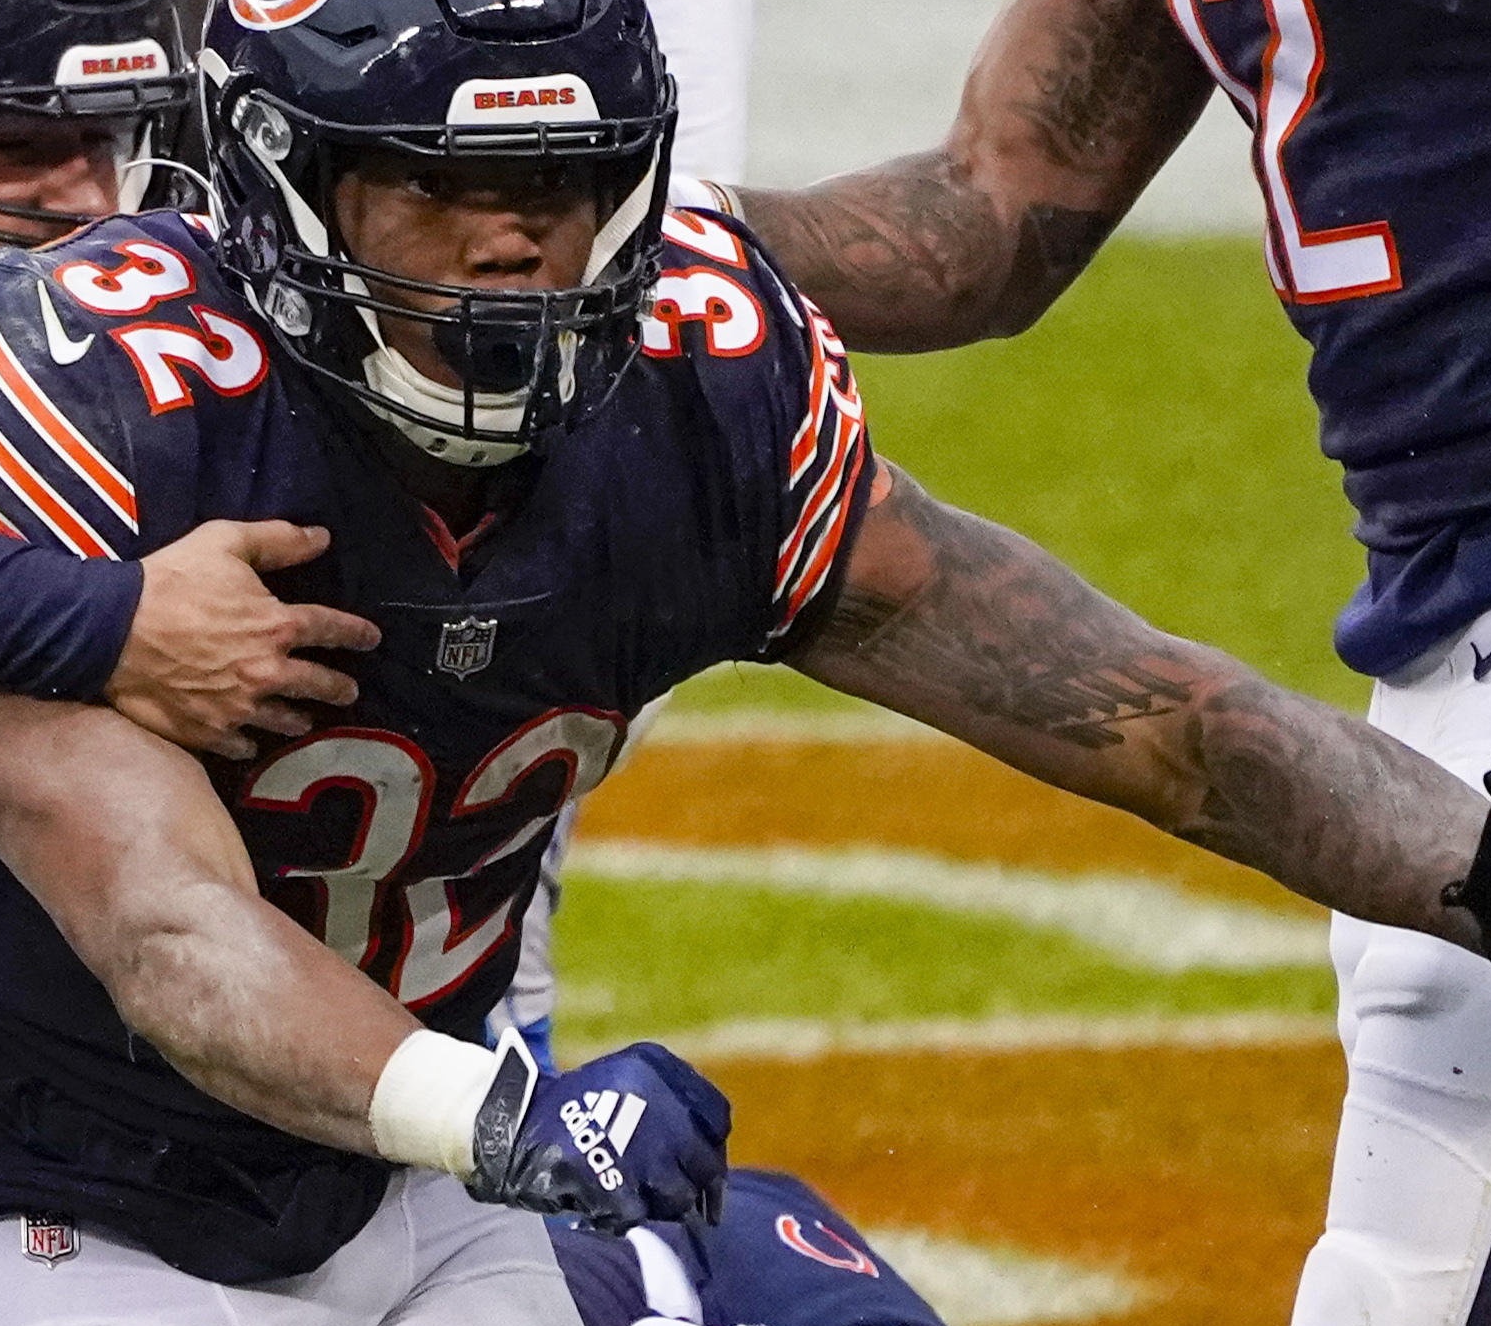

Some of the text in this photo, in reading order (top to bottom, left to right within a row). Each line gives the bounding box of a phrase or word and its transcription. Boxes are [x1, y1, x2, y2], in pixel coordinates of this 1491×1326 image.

[81, 53, 158, 76] BEARS
[473, 87, 577, 110] BEARS
[52, 238, 270, 416] 32
[444, 643, 485, 666] NFL
[241, 704, 627, 1014] 32
[559, 1099, 625, 1212] adidas
[31, 1227, 71, 1255] NFL
